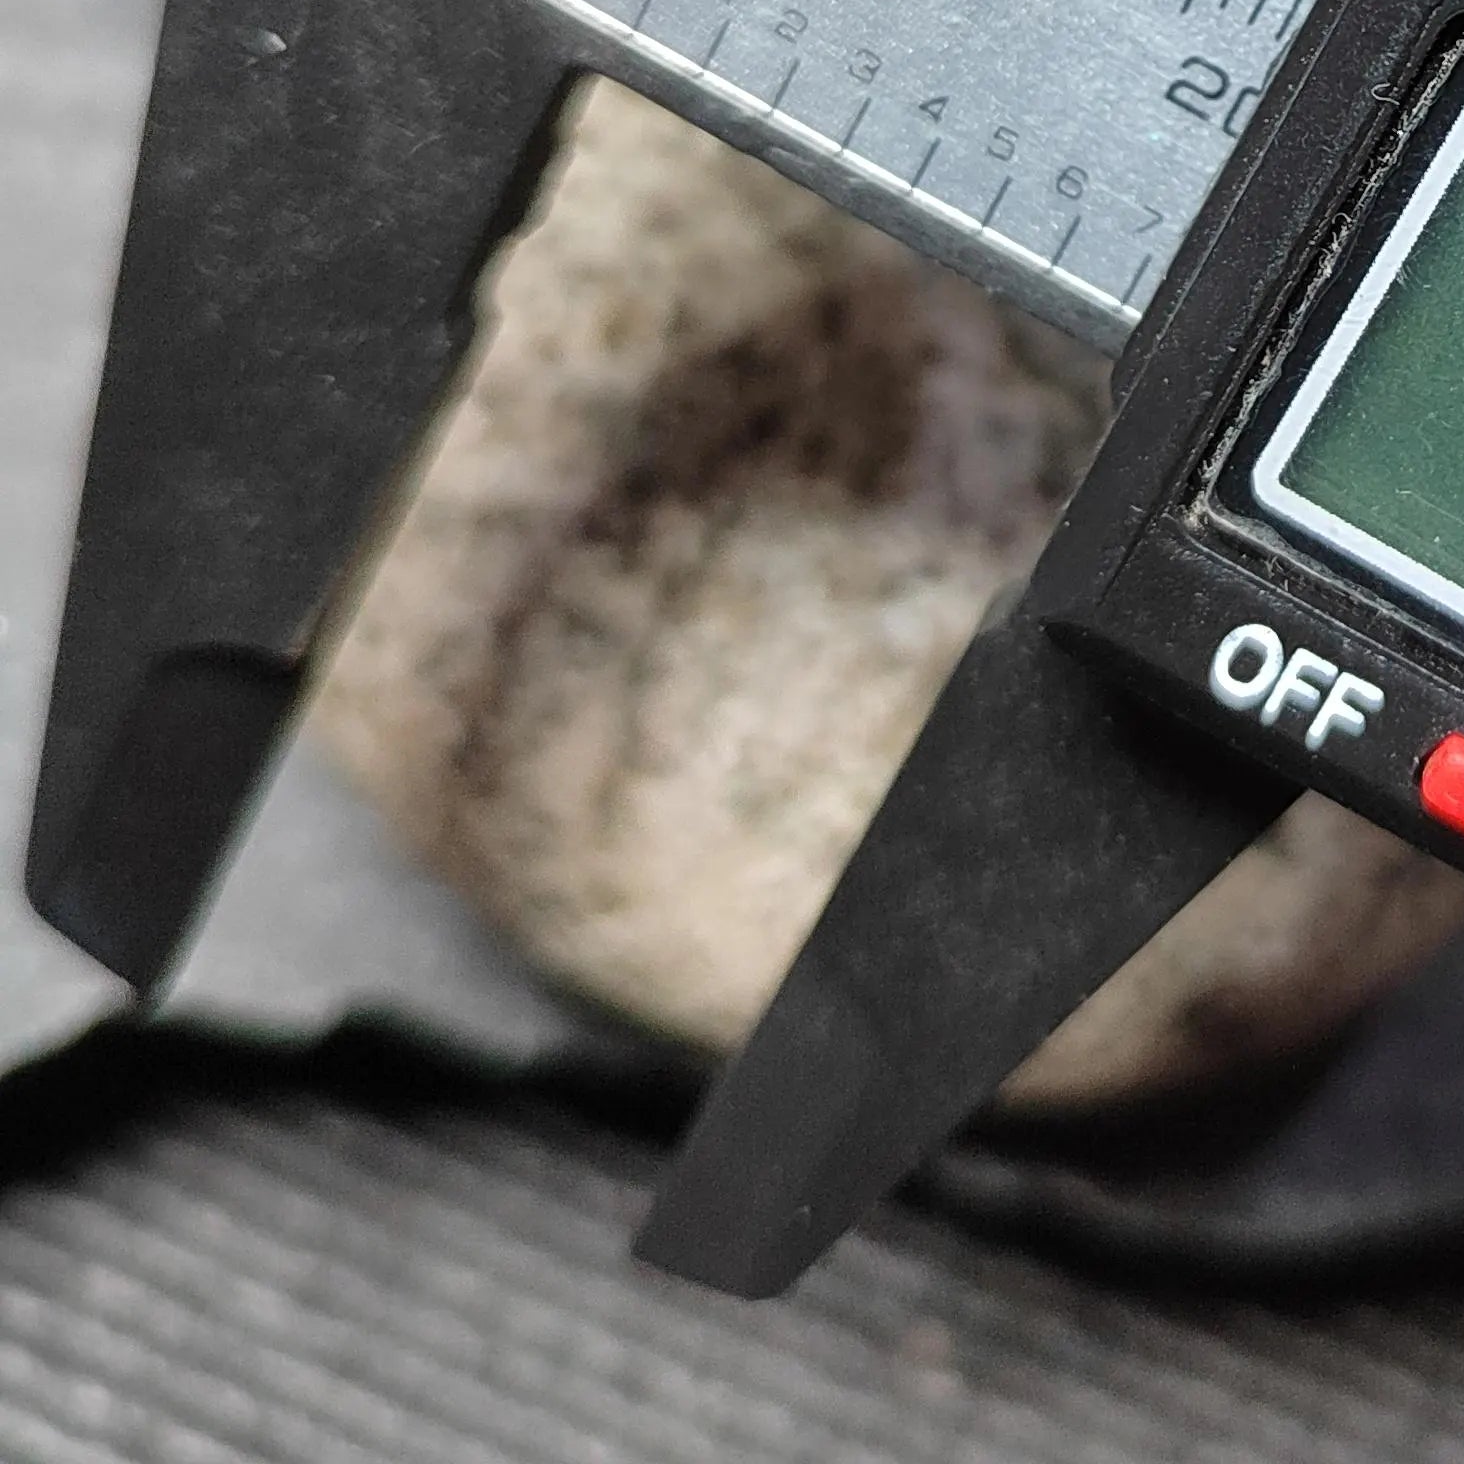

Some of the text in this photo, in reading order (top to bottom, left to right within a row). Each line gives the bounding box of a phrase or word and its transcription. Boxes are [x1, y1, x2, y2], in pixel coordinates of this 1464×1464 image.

[774, 9, 810, 44] 2
[848, 49, 883, 84] 3
[918, 94, 950, 125] 4
[987, 128, 1019, 162] 5
[1056, 167, 1088, 203] 6
[1131, 207, 1165, 235] 7
[1209, 623, 1384, 751] OFF
